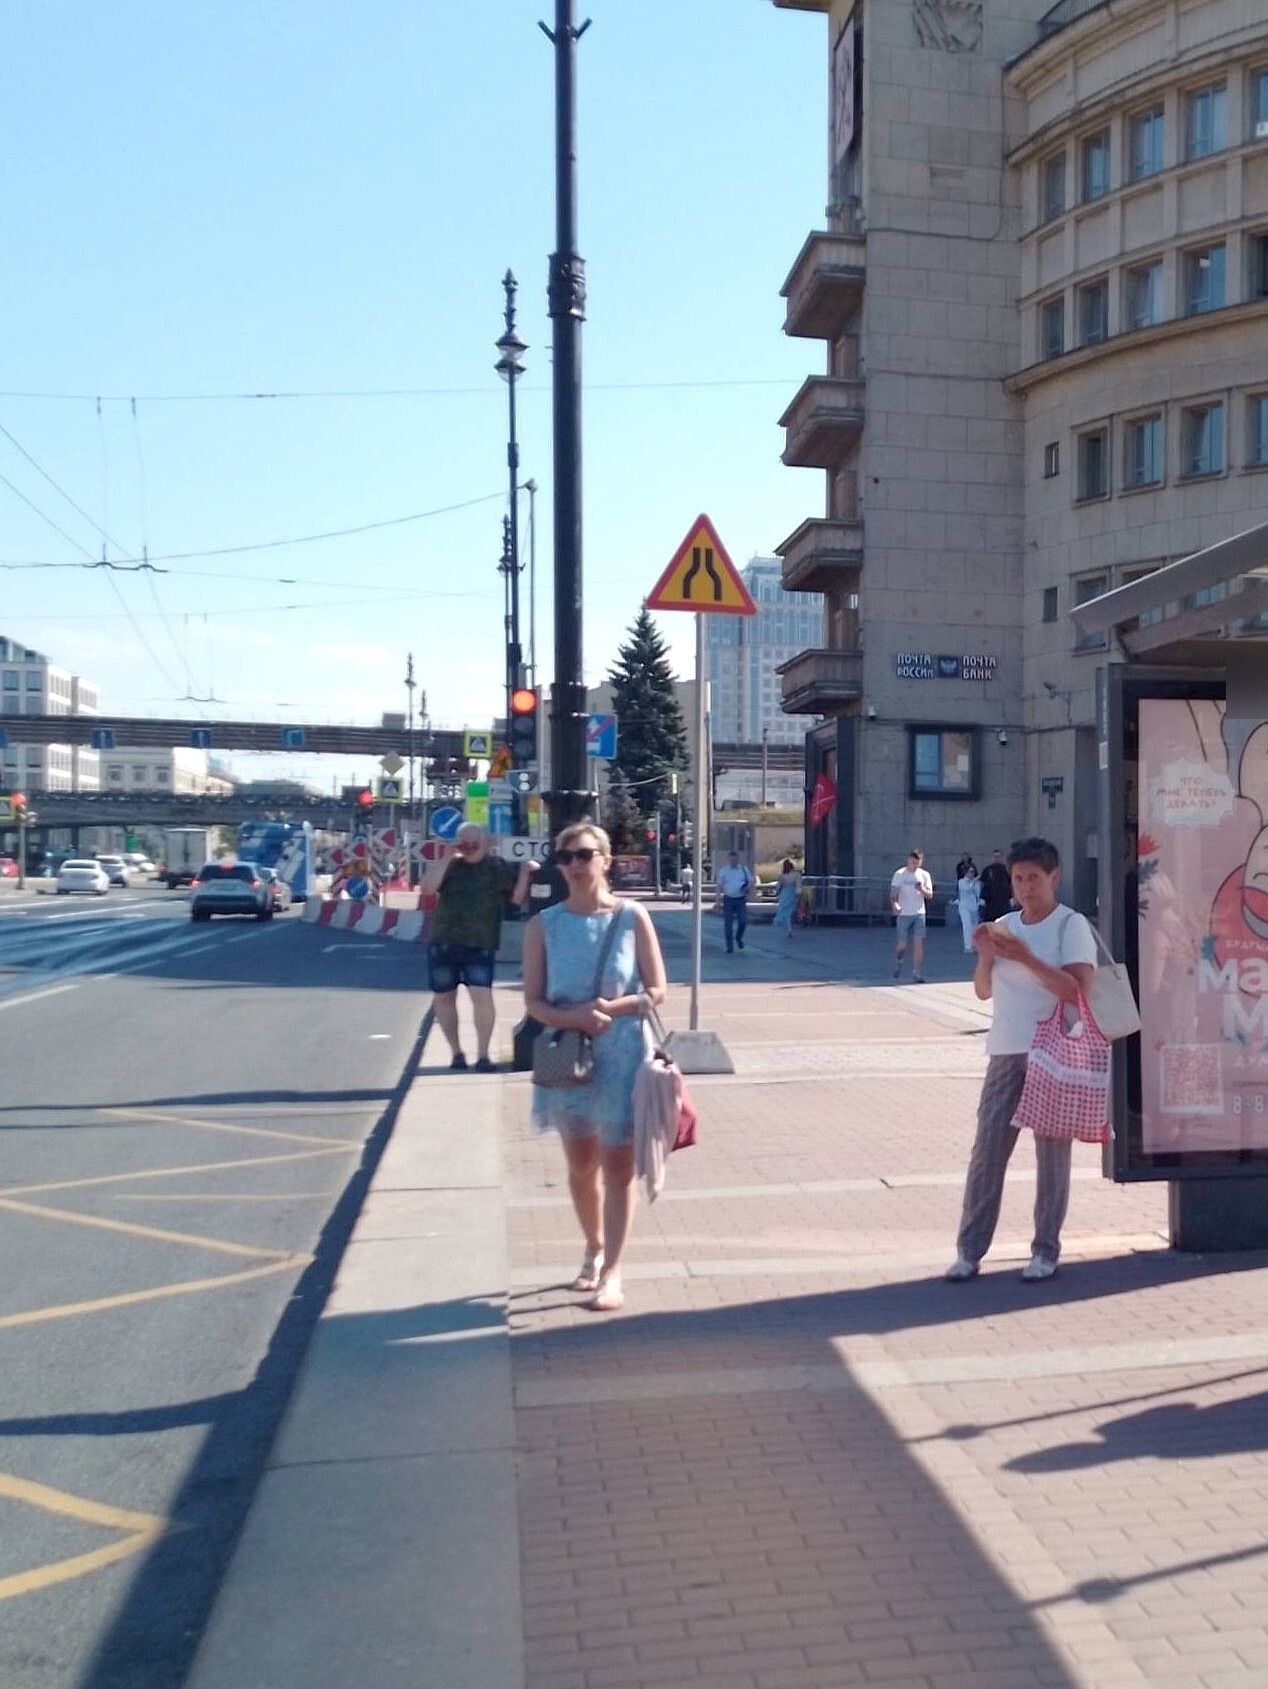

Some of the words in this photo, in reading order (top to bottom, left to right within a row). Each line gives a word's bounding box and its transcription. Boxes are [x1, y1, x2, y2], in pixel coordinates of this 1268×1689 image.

[897, 652, 931, 665] ПОЧТА
[962, 655, 996, 667] ПОЧТА
[897, 666, 933, 678] РОССИИ
[962, 668, 992, 680] БАНК
